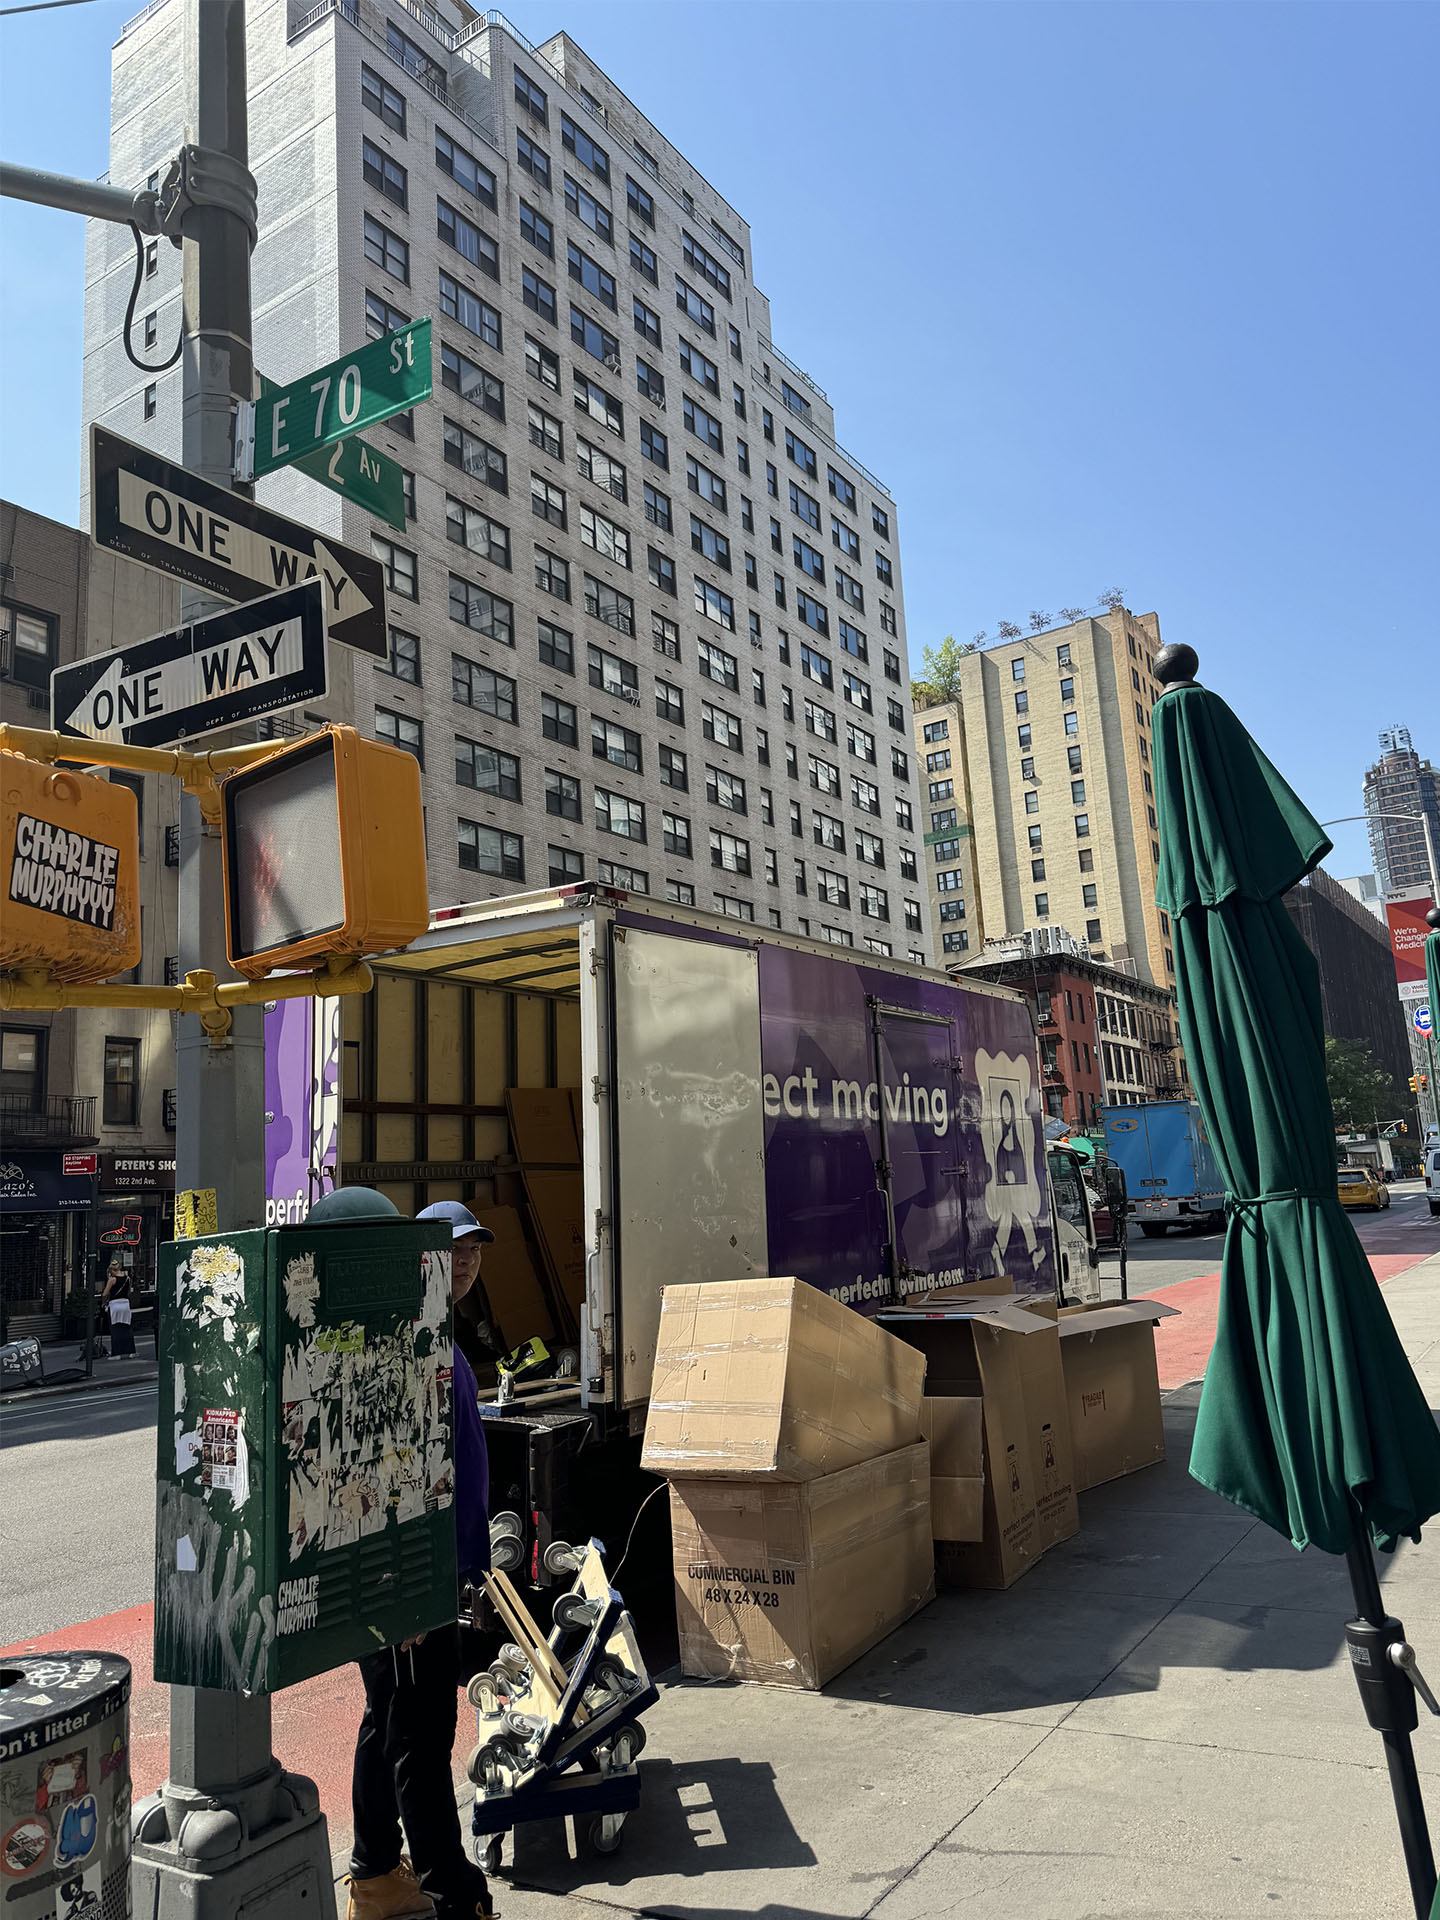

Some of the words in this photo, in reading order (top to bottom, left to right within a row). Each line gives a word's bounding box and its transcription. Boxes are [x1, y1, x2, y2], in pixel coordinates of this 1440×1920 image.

[271, 397, 290, 458] E
[311, 364, 361, 438] 70
[389, 331, 414, 374] St
[328, 440, 345, 486] 2
[359, 447, 381, 484] Av
[145, 490, 232, 565] ONE
[110, 539, 132, 552] DEPT
[141, 552, 151, 560] OF
[160, 560, 230, 593] TRANSPORTATION
[93, 670, 163, 731] ONE
[201, 628, 285, 696] WAY
[206, 716, 224, 727] DEPT
[247, 688, 314, 713] TRANSPORTATION
[17, 815, 119, 886] CHARLIE
[11, 857, 115, 929] MURPHYYY
[1387, 891, 1407, 900] NYC
[1393, 927, 1418, 936] We're
[763, 1067, 820, 1118] ect
[832, 1071, 949, 1137] moving
[114, 1160, 155, 1171] PETER'S
[115, 1177, 130, 1185] 1322
[131, 1177, 142, 1185] 2nd
[0, 1180, 35, 1191] azo's
[266, 1189, 329, 1226] perfe
[206, 1409, 236, 1417] KIDNAPPED
[207, 1416, 234, 1424] Americans
[278, 1574, 320, 1609] CHARLIE
[687, 1564, 770, 1584] COMMERCIAL
[772, 1569, 796, 1585] BIN
[705, 1587, 722, 1603] 48
[723, 1589, 733, 1604] X
[734, 1589, 750, 1605] 24
[752, 1590, 762, 1606] X
[762, 1592, 780, 1608] 28
[44, 1711, 91, 1743] litter
